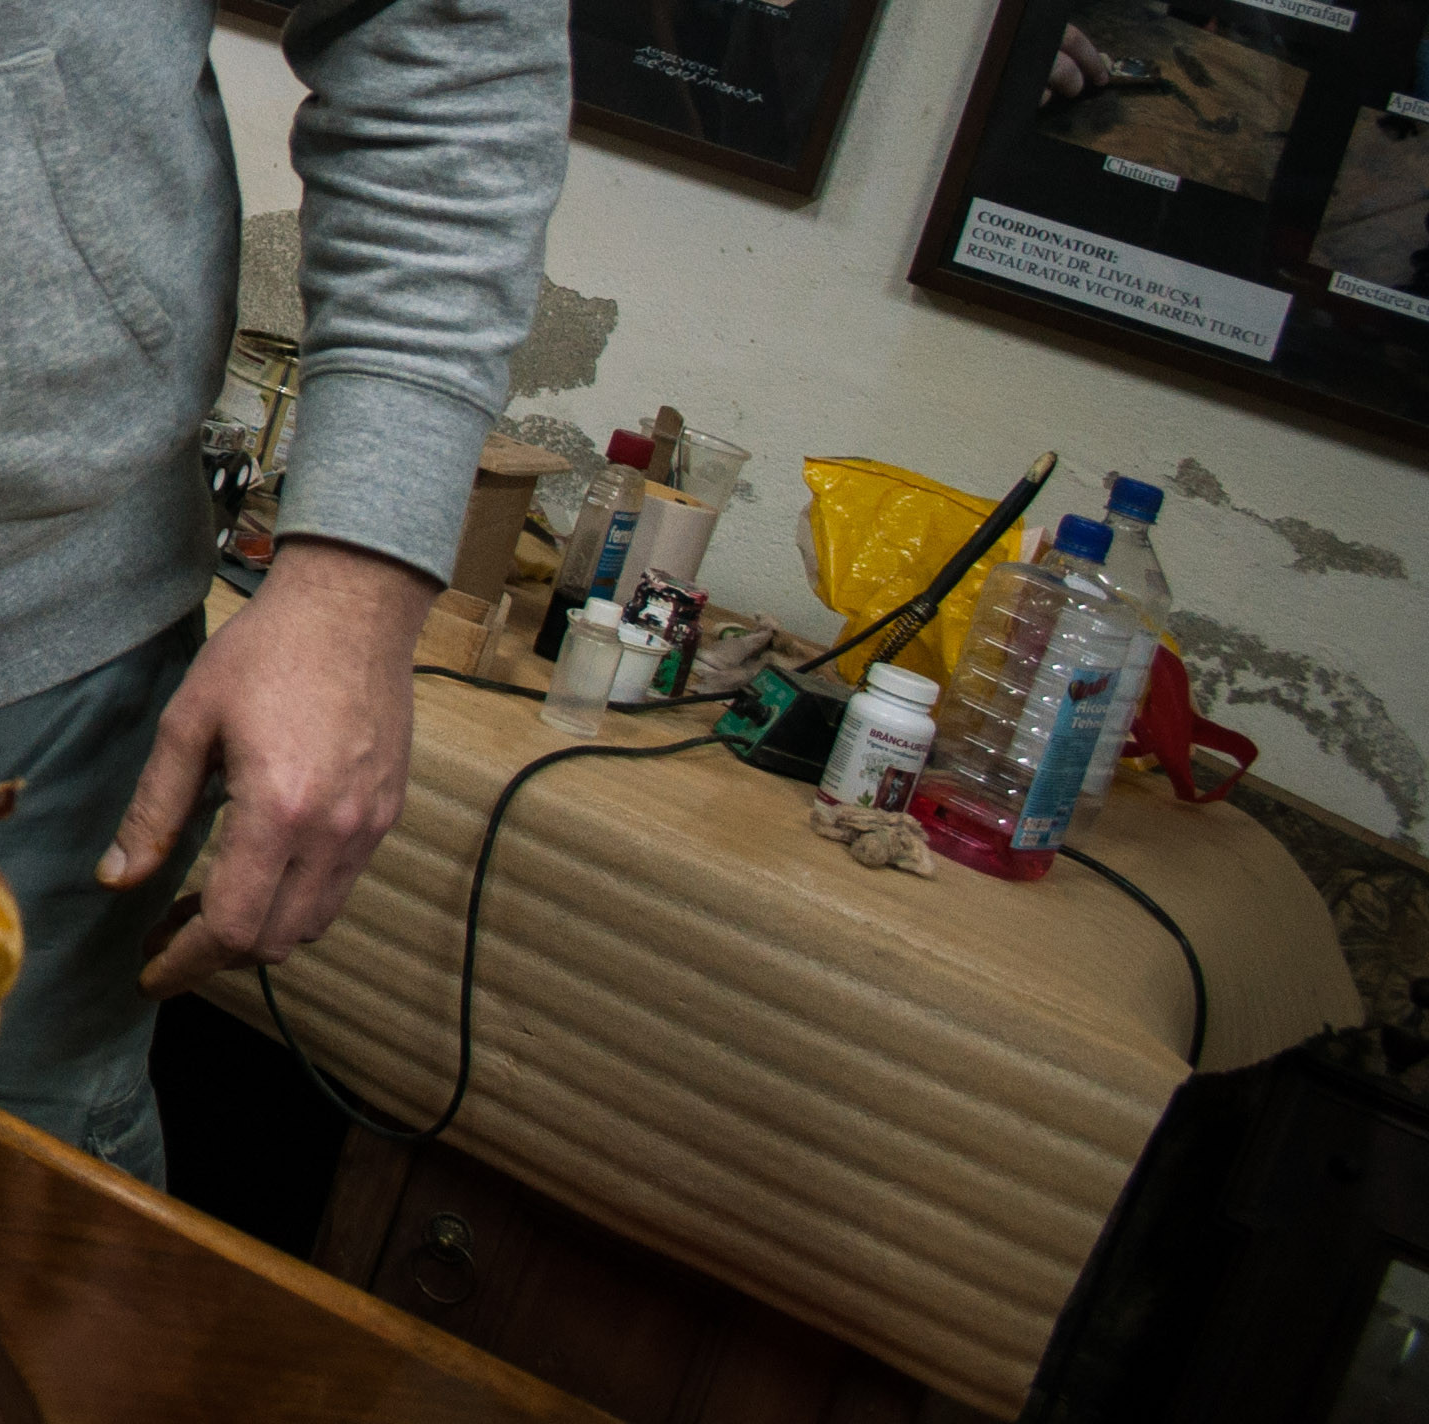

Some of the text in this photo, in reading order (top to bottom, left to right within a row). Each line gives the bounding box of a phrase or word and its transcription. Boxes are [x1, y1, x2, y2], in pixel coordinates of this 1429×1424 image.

[1105, 156, 1178, 193] Chituirea
[972, 226, 1018, 253] CONF.
[1020, 241, 1064, 267] UNIV.
[1097, 264, 1143, 290] LIVIA
[977, 209, 1120, 265] COORDONATORI:
[966, 242, 1081, 291] RESTAURATOR
[1084, 279, 1146, 312] VICTOR
[1208, 316, 1269, 349] TURCU
